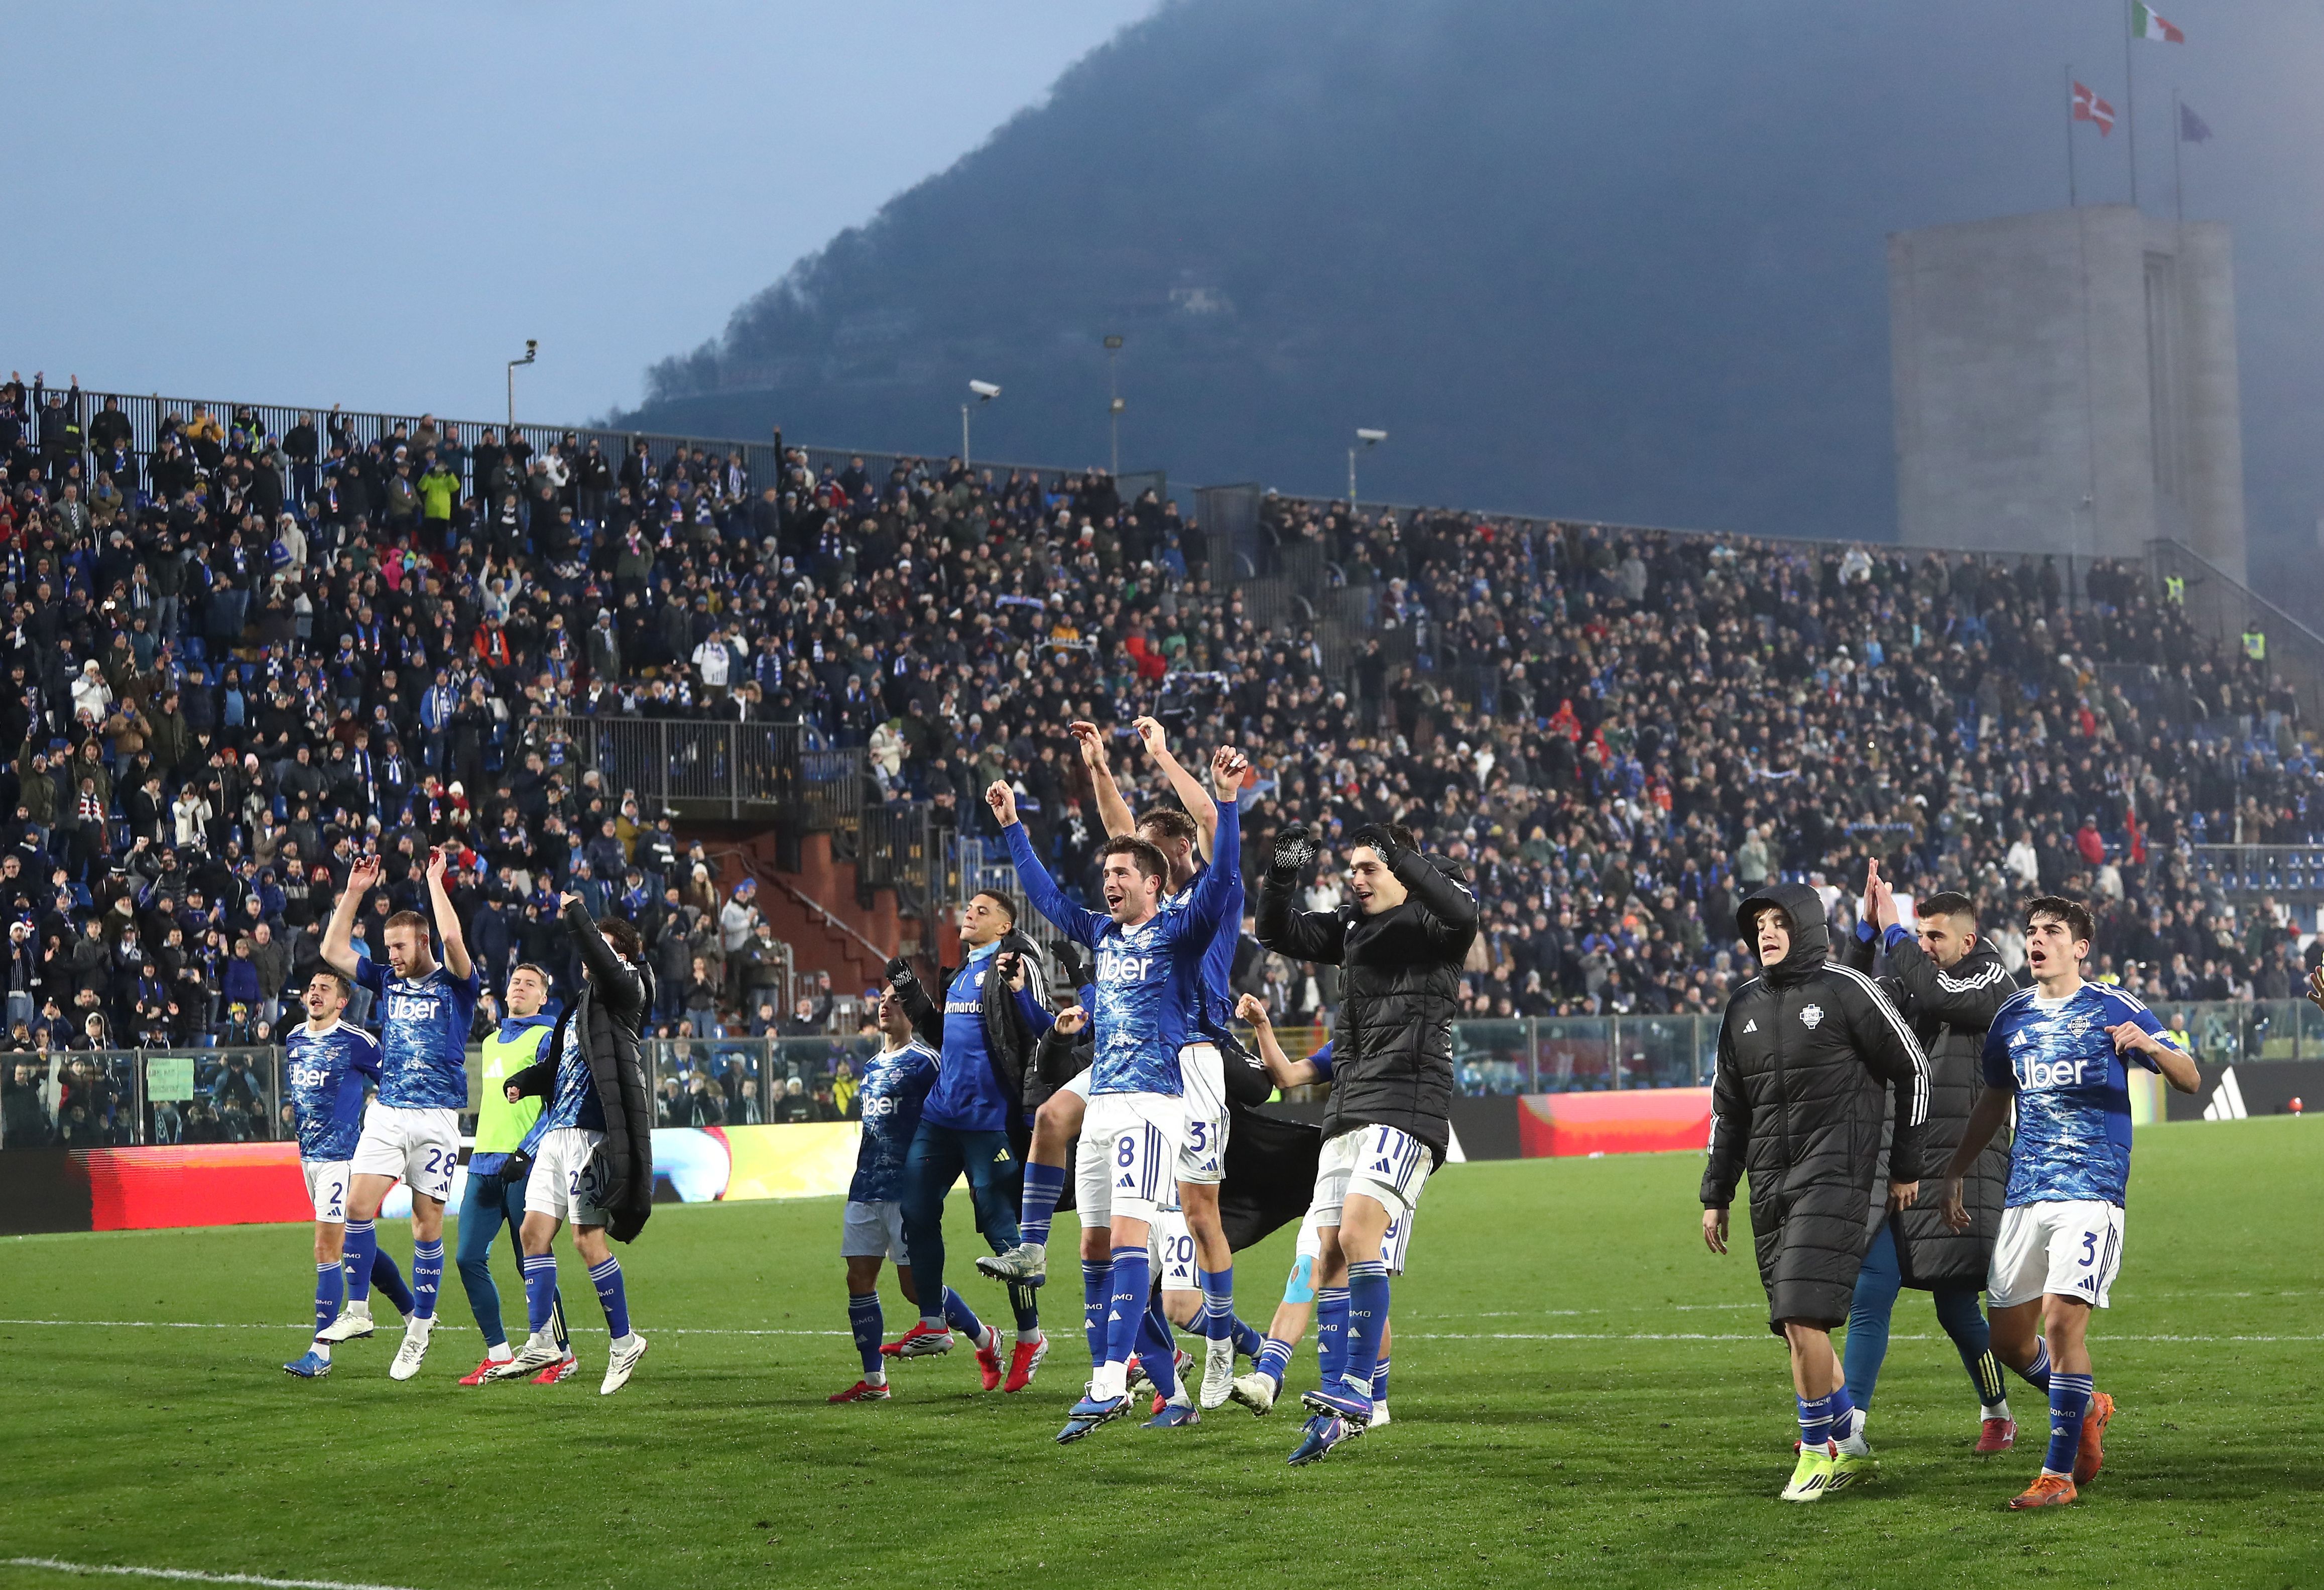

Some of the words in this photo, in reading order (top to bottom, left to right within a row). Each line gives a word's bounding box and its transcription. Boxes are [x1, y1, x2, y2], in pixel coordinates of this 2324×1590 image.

[1096, 951, 1153, 982] Uber
[388, 995, 440, 1019] Uber
[944, 999, 984, 1015] Bernardo
[289, 1063, 330, 1086] Uber
[2012, 1056, 2088, 1090] Uber
[1189, 1121, 1217, 1154] 31
[1376, 1127, 1405, 1160] 11
[425, 1148, 457, 1177] 28
[1118, 1136, 1135, 1167] 8
[569, 1165, 597, 1195] 23
[330, 1182, 343, 1204] 2
[1165, 1236, 1193, 1263] 20
[2078, 1231, 2098, 1267] 3
[415, 1267, 440, 1275] COMO
[1111, 1293, 1133, 1303] OMO
[853, 1316, 874, 1326] OMO
[1349, 1310, 1371, 1318] OMO
[2050, 1407, 2076, 1418] COMO
